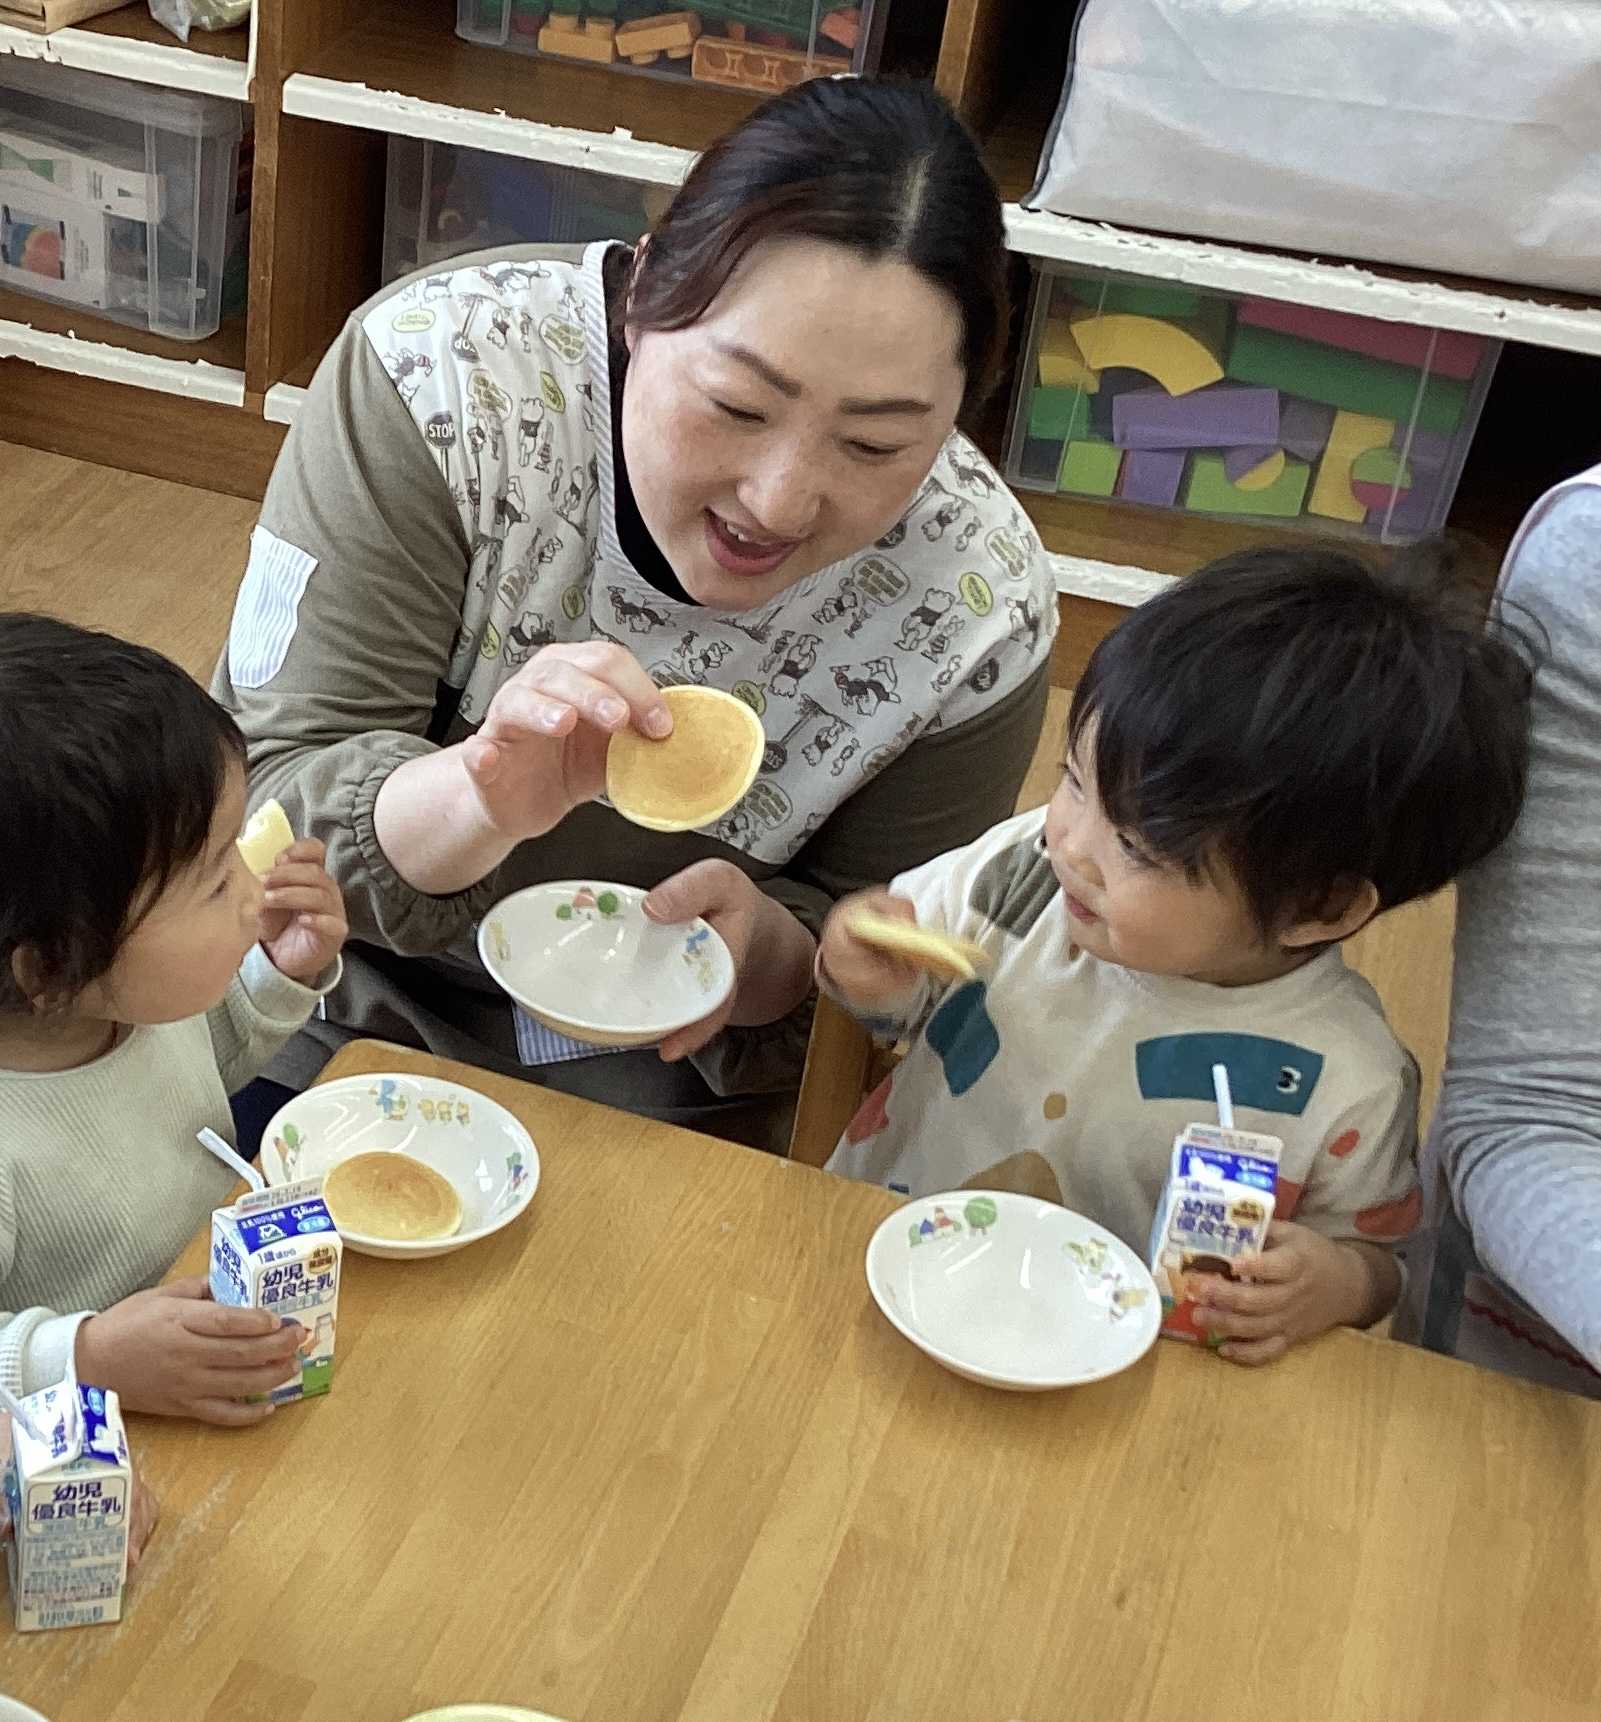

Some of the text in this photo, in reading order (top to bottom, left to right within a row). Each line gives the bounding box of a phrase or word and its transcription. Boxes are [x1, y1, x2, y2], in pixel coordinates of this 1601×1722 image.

[428, 422, 455, 438] STOP
[261, 1272, 335, 1305] 優良牛乳
[262, 1263, 304, 1289] 幼児
[53, 1481, 103, 1503] 幼児
[31, 1496, 122, 1521] 優良牛乳
